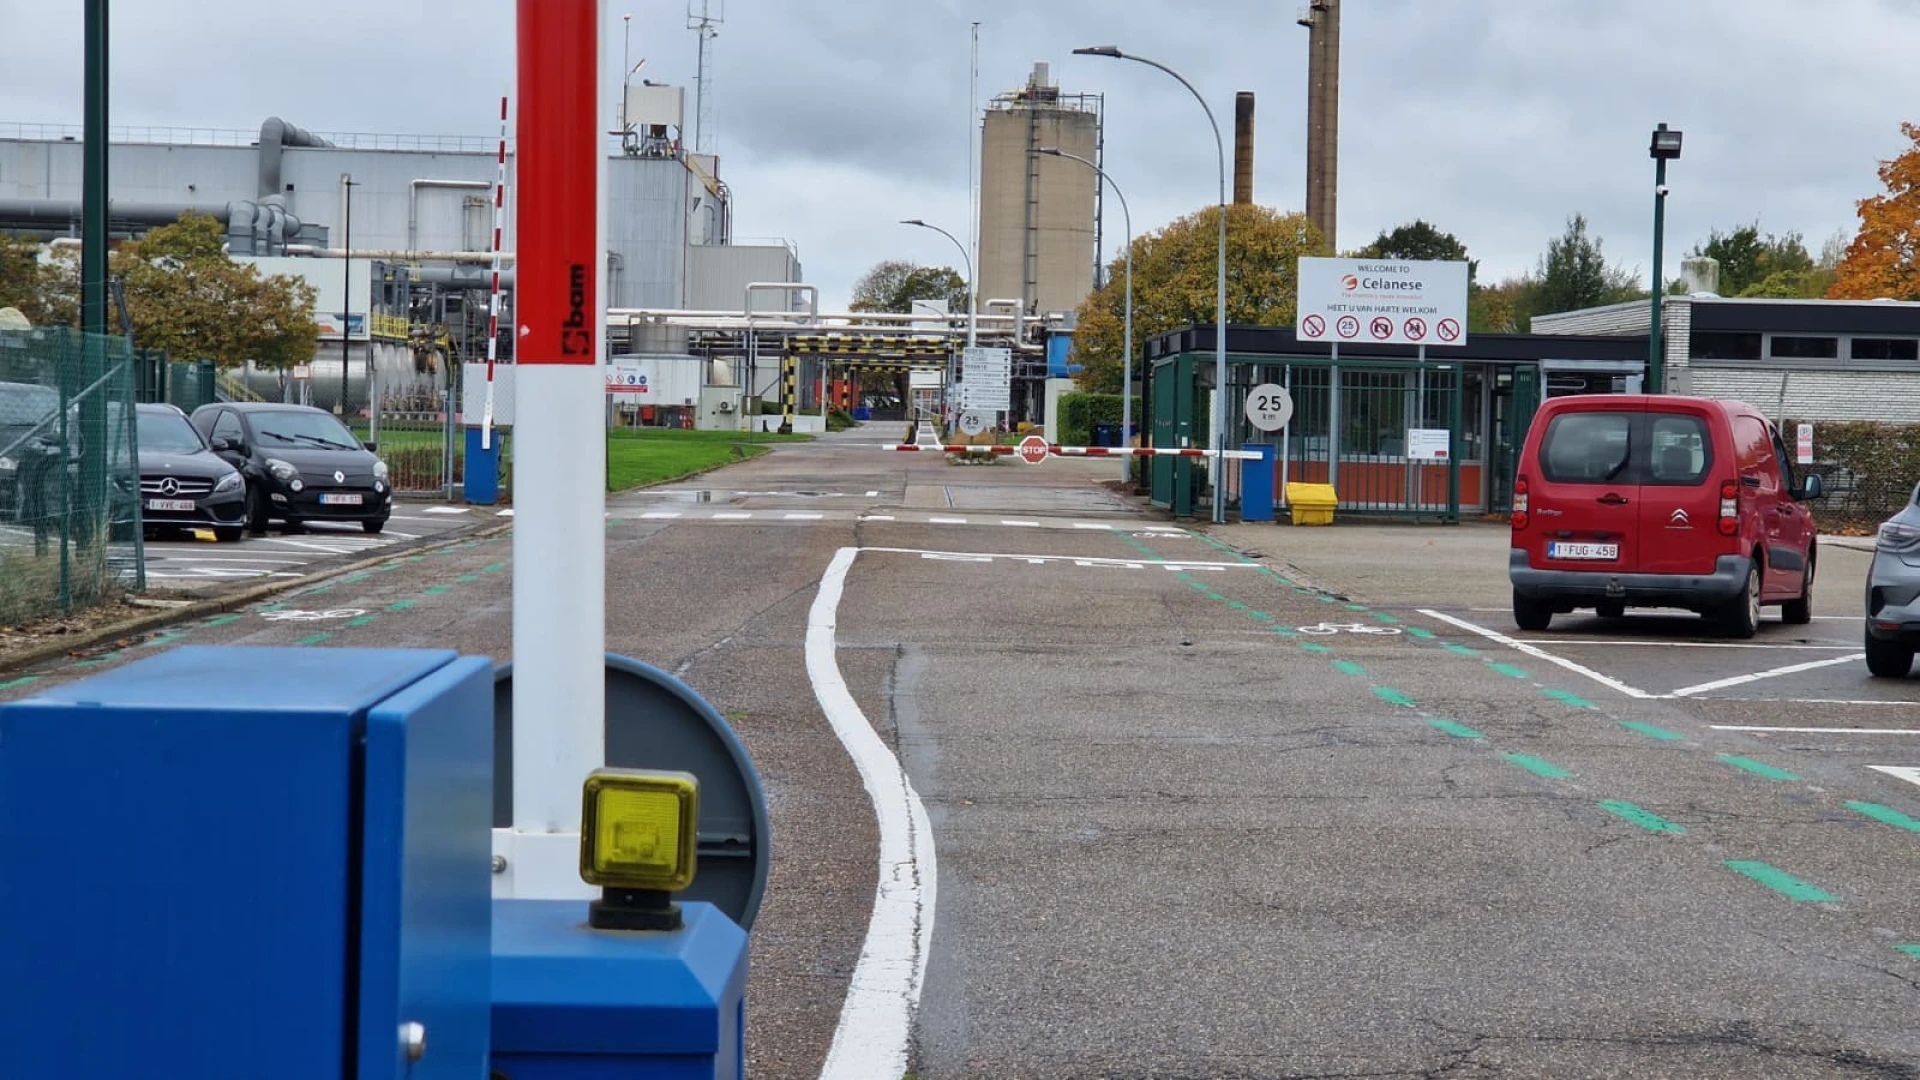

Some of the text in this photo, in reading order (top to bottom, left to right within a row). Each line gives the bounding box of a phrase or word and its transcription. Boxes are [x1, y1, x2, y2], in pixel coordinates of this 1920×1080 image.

[1358, 264, 1410, 274] WELCOME TO
[1362, 278, 1423, 291] Celanese
[563, 264, 584, 328] bam
[1327, 304, 1347, 312] HEET
[1355, 305, 1373, 313] VAN
[1375, 305, 1400, 313] HARTE
[1402, 306, 1438, 314] WELKOM
[1342, 320, 1354, 329] 25
[1257, 395, 1281, 411] 25
[965, 416, 979, 425] 25
[1022, 446, 1046, 455] STOP
[1557, 545, 1616, 557] 1-FUG-458
